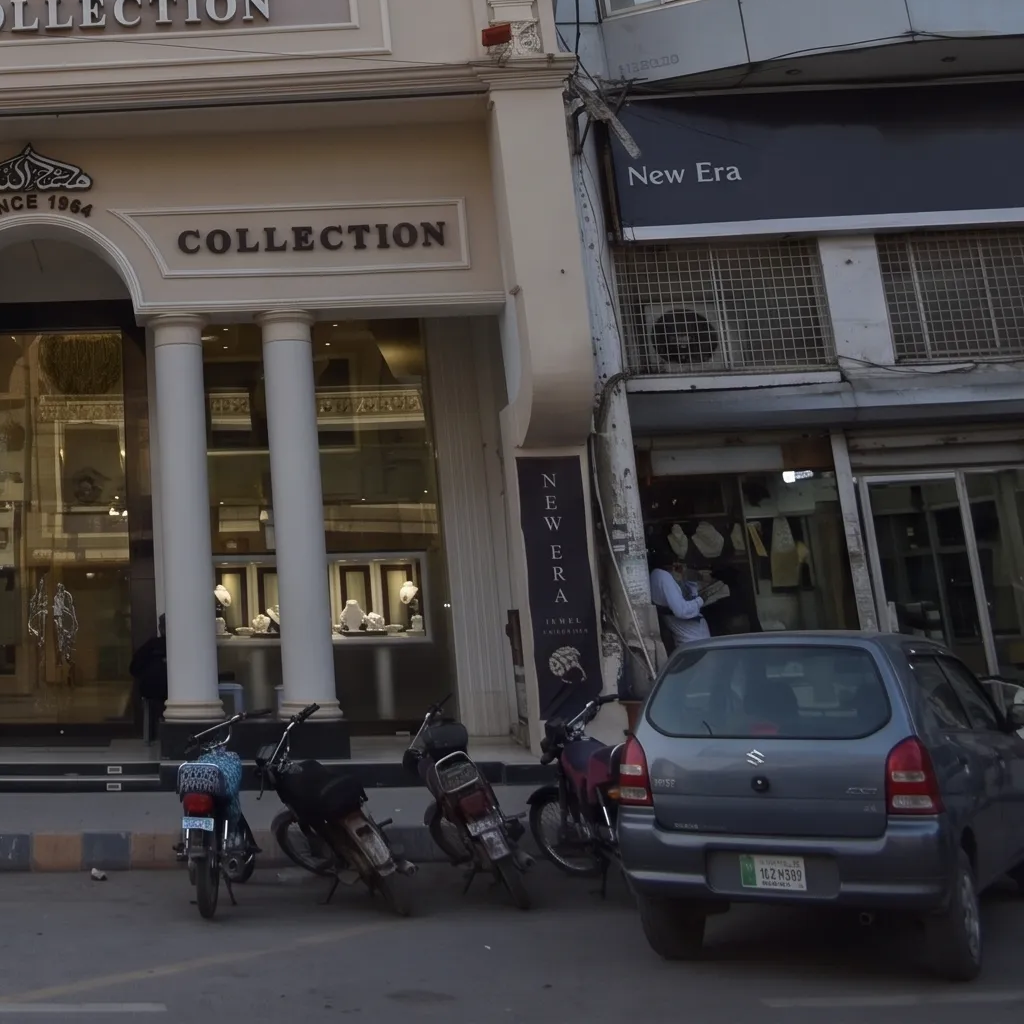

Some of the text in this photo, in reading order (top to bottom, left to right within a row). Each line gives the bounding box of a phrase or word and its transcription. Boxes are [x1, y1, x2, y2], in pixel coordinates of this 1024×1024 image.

[627, 161, 743, 186] New Era
[47, 194, 93, 218] 1964
[177, 221, 447, 255] COLLECTION
[540, 473, 563, 531] NEW
[550, 544, 569, 603] ERA
